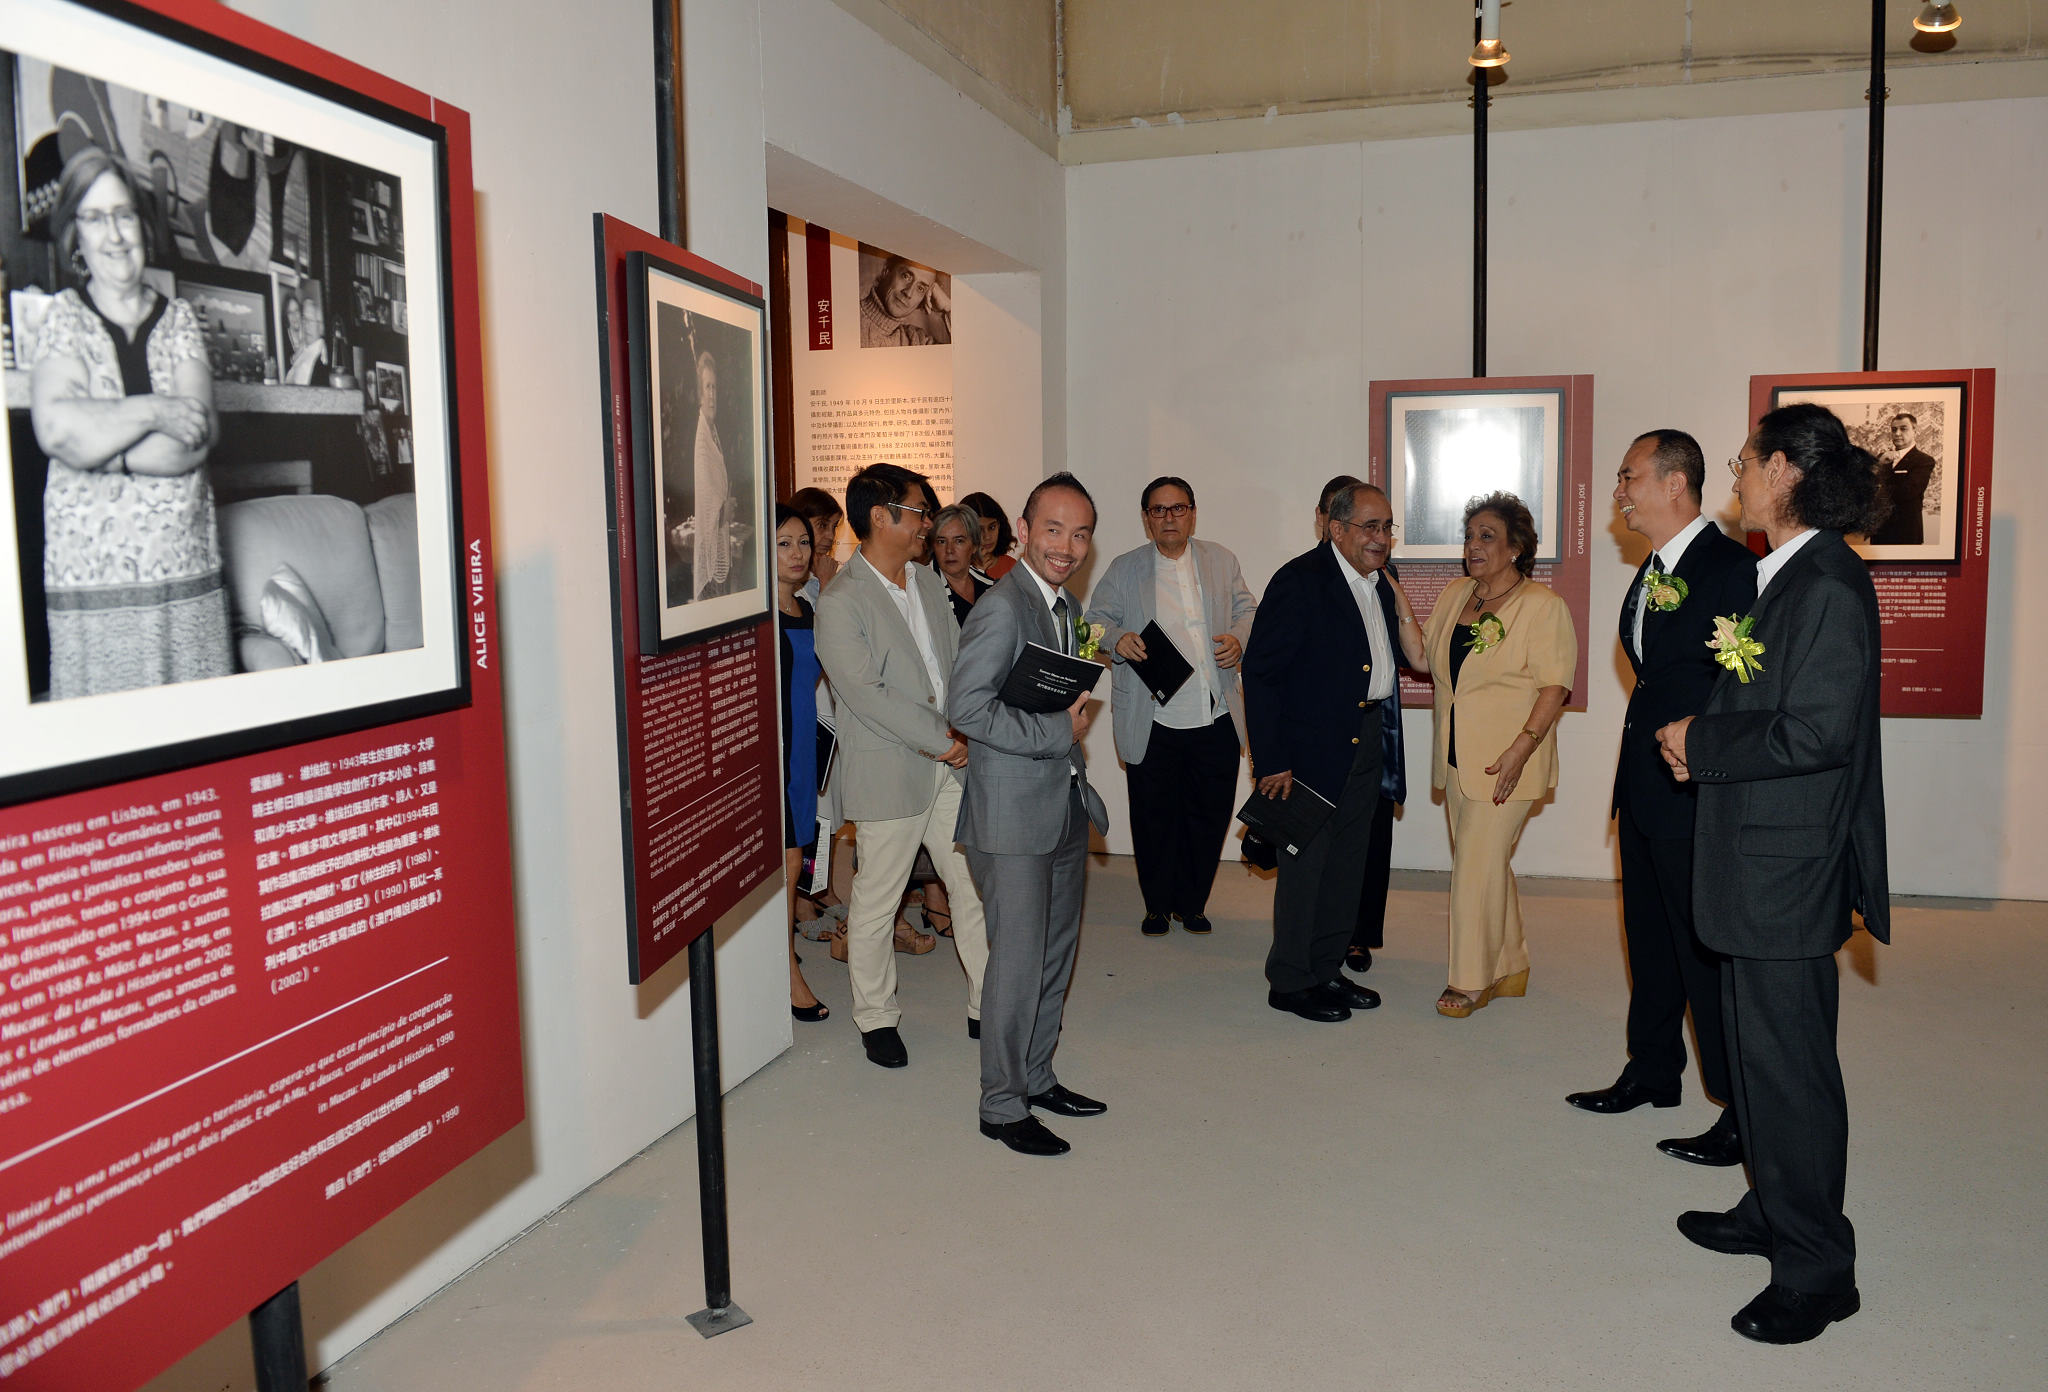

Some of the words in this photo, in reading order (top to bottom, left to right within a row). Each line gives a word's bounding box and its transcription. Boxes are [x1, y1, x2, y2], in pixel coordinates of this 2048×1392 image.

[818, 299, 830, 344] 安千民
[470, 538, 484, 606] VIEIRA
[474, 610, 488, 669] ALICE
[21, 853, 45, 869] em
[48, 838, 106, 862] Filologia
[107, 821, 172, 846] Germânica
[173, 819, 183, 829] e
[185, 809, 222, 827] autora
[32, 821, 84, 843] nasceu
[86, 815, 110, 830] em
[111, 804, 160, 824] Lisboa,
[161, 798, 182, 812] em
[185, 788, 219, 805] 1943.
[30, 892, 71, 916] poeta
[71, 889, 82, 901] e
[83, 872, 143, 901] jornalista
[144, 858, 190, 880] recebeu
[190, 848, 225, 866] vários
[36, 866, 81, 891] poesia
[79, 864, 90, 876] e
[90, 849, 145, 873] literatura
[143, 826, 223, 858] infanto-juvenil,
[12, 913, 78, 942] literários,
[80, 899, 120, 921] tendo
[121, 896, 133, 908] o
[134, 880, 187, 904] conjunto
[188, 873, 205, 887] da
[206, 867, 227, 882] sua
[20, 928, 97, 963] distinguido
[96, 922, 119, 938] em
[120, 909, 152, 930] 1994
[150, 903, 178, 920] com
[176, 900, 188, 912] o
[186, 886, 228, 908] Grande
[10, 954, 91, 990] Gulbenkian.
[95, 939, 133, 961] Sobre
[136, 925, 179, 946] Macau,
[182, 919, 191, 931] a
[194, 906, 230, 926] autora
